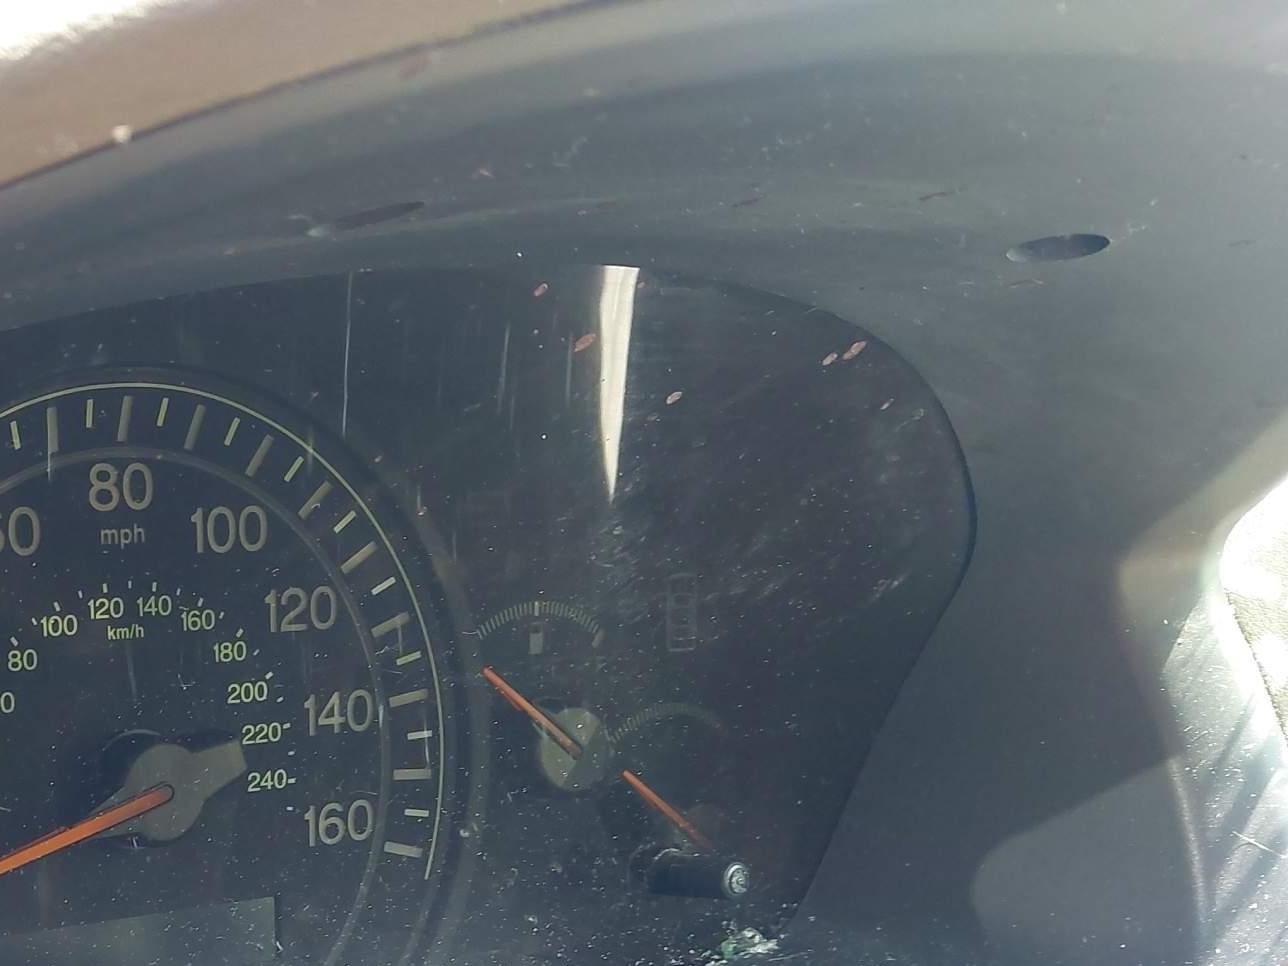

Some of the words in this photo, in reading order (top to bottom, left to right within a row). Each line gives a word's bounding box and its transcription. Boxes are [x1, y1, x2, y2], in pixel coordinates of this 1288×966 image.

[88, 461, 154, 512] 80
[99, 523, 146, 547] mph
[190, 505, 268, 554] 100
[87, 597, 124, 620] 120
[136, 595, 172, 618] 140
[265, 586, 337, 633] 120
[40, 614, 78, 637] 100
[106, 623, 144, 641] km/h
[180, 609, 215, 632] 160
[7, 649, 38, 671] 80
[212, 641, 247, 663] 180
[227, 681, 268, 703] 200
[304, 689, 373, 736] 140
[241, 723, 282, 745] 220
[247, 770, 287, 792] 240
[304, 799, 373, 847] 160
